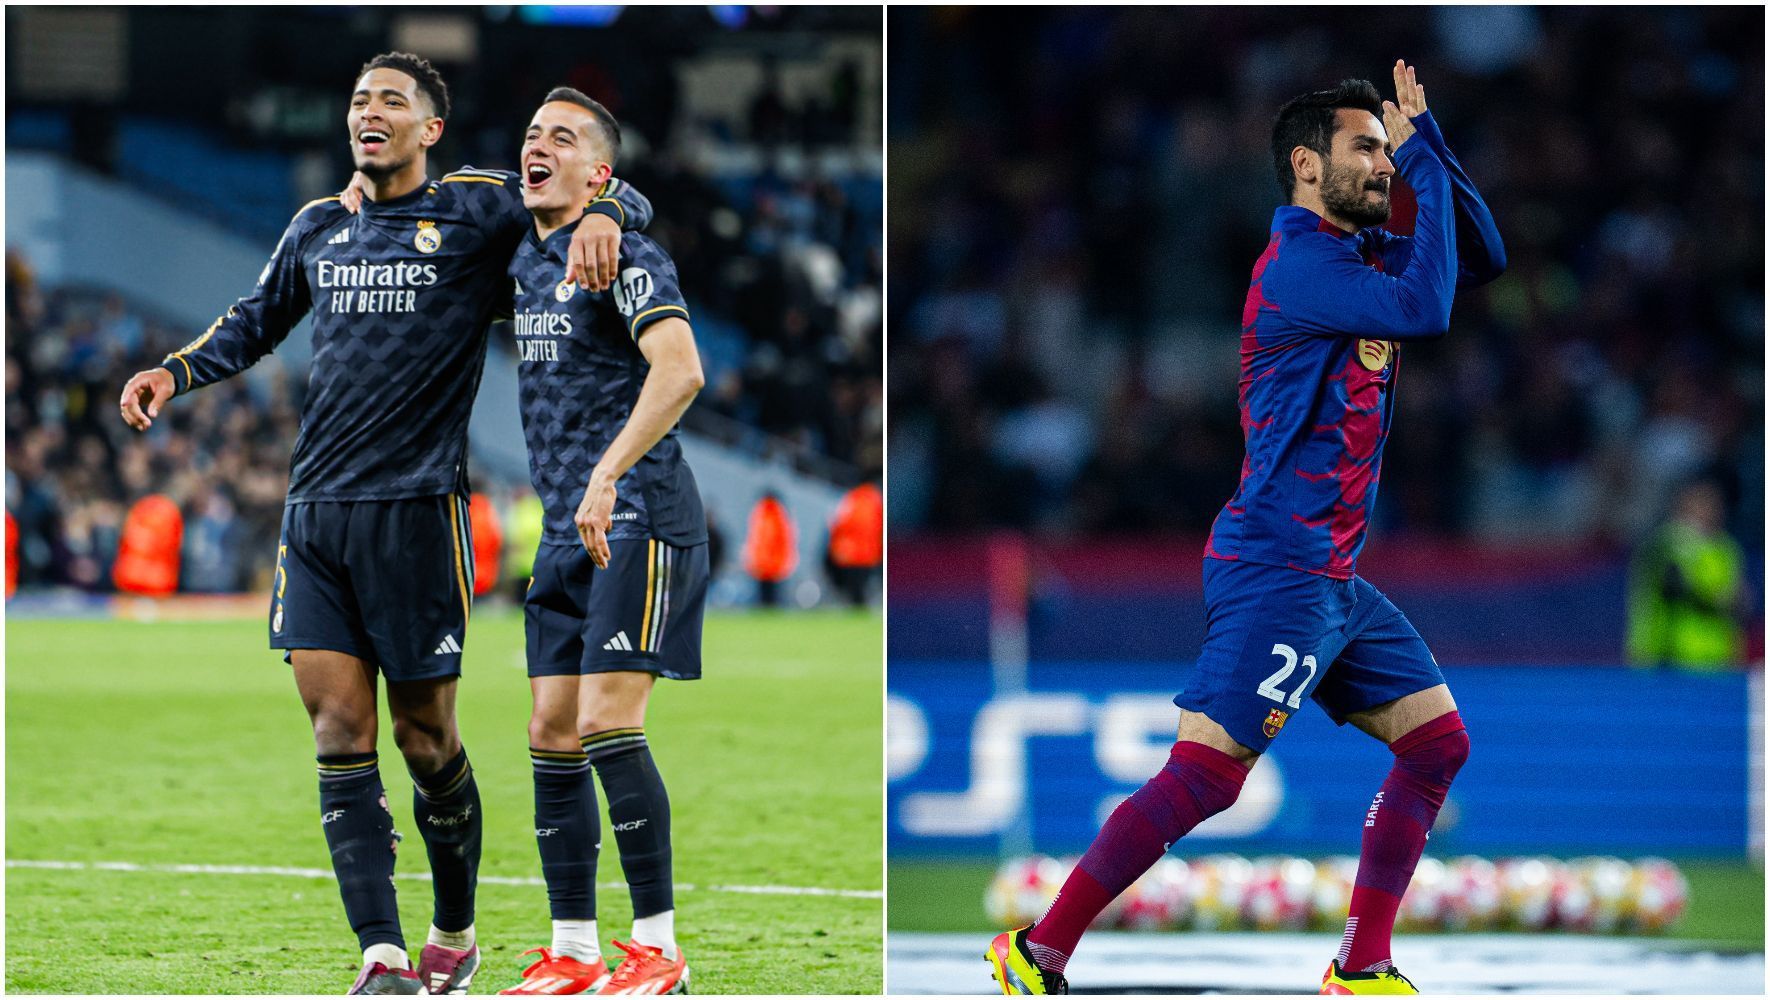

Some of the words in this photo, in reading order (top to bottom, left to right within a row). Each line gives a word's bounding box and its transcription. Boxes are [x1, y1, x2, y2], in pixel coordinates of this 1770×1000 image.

[318, 259, 438, 288] Emirates
[331, 291, 354, 313] FLY
[357, 290, 416, 313] BETTER
[514, 307, 572, 335] mirates
[1256, 643, 1317, 709] 22
[1365, 791, 1385, 827] BARÇA
[535, 828, 559, 837] CF
